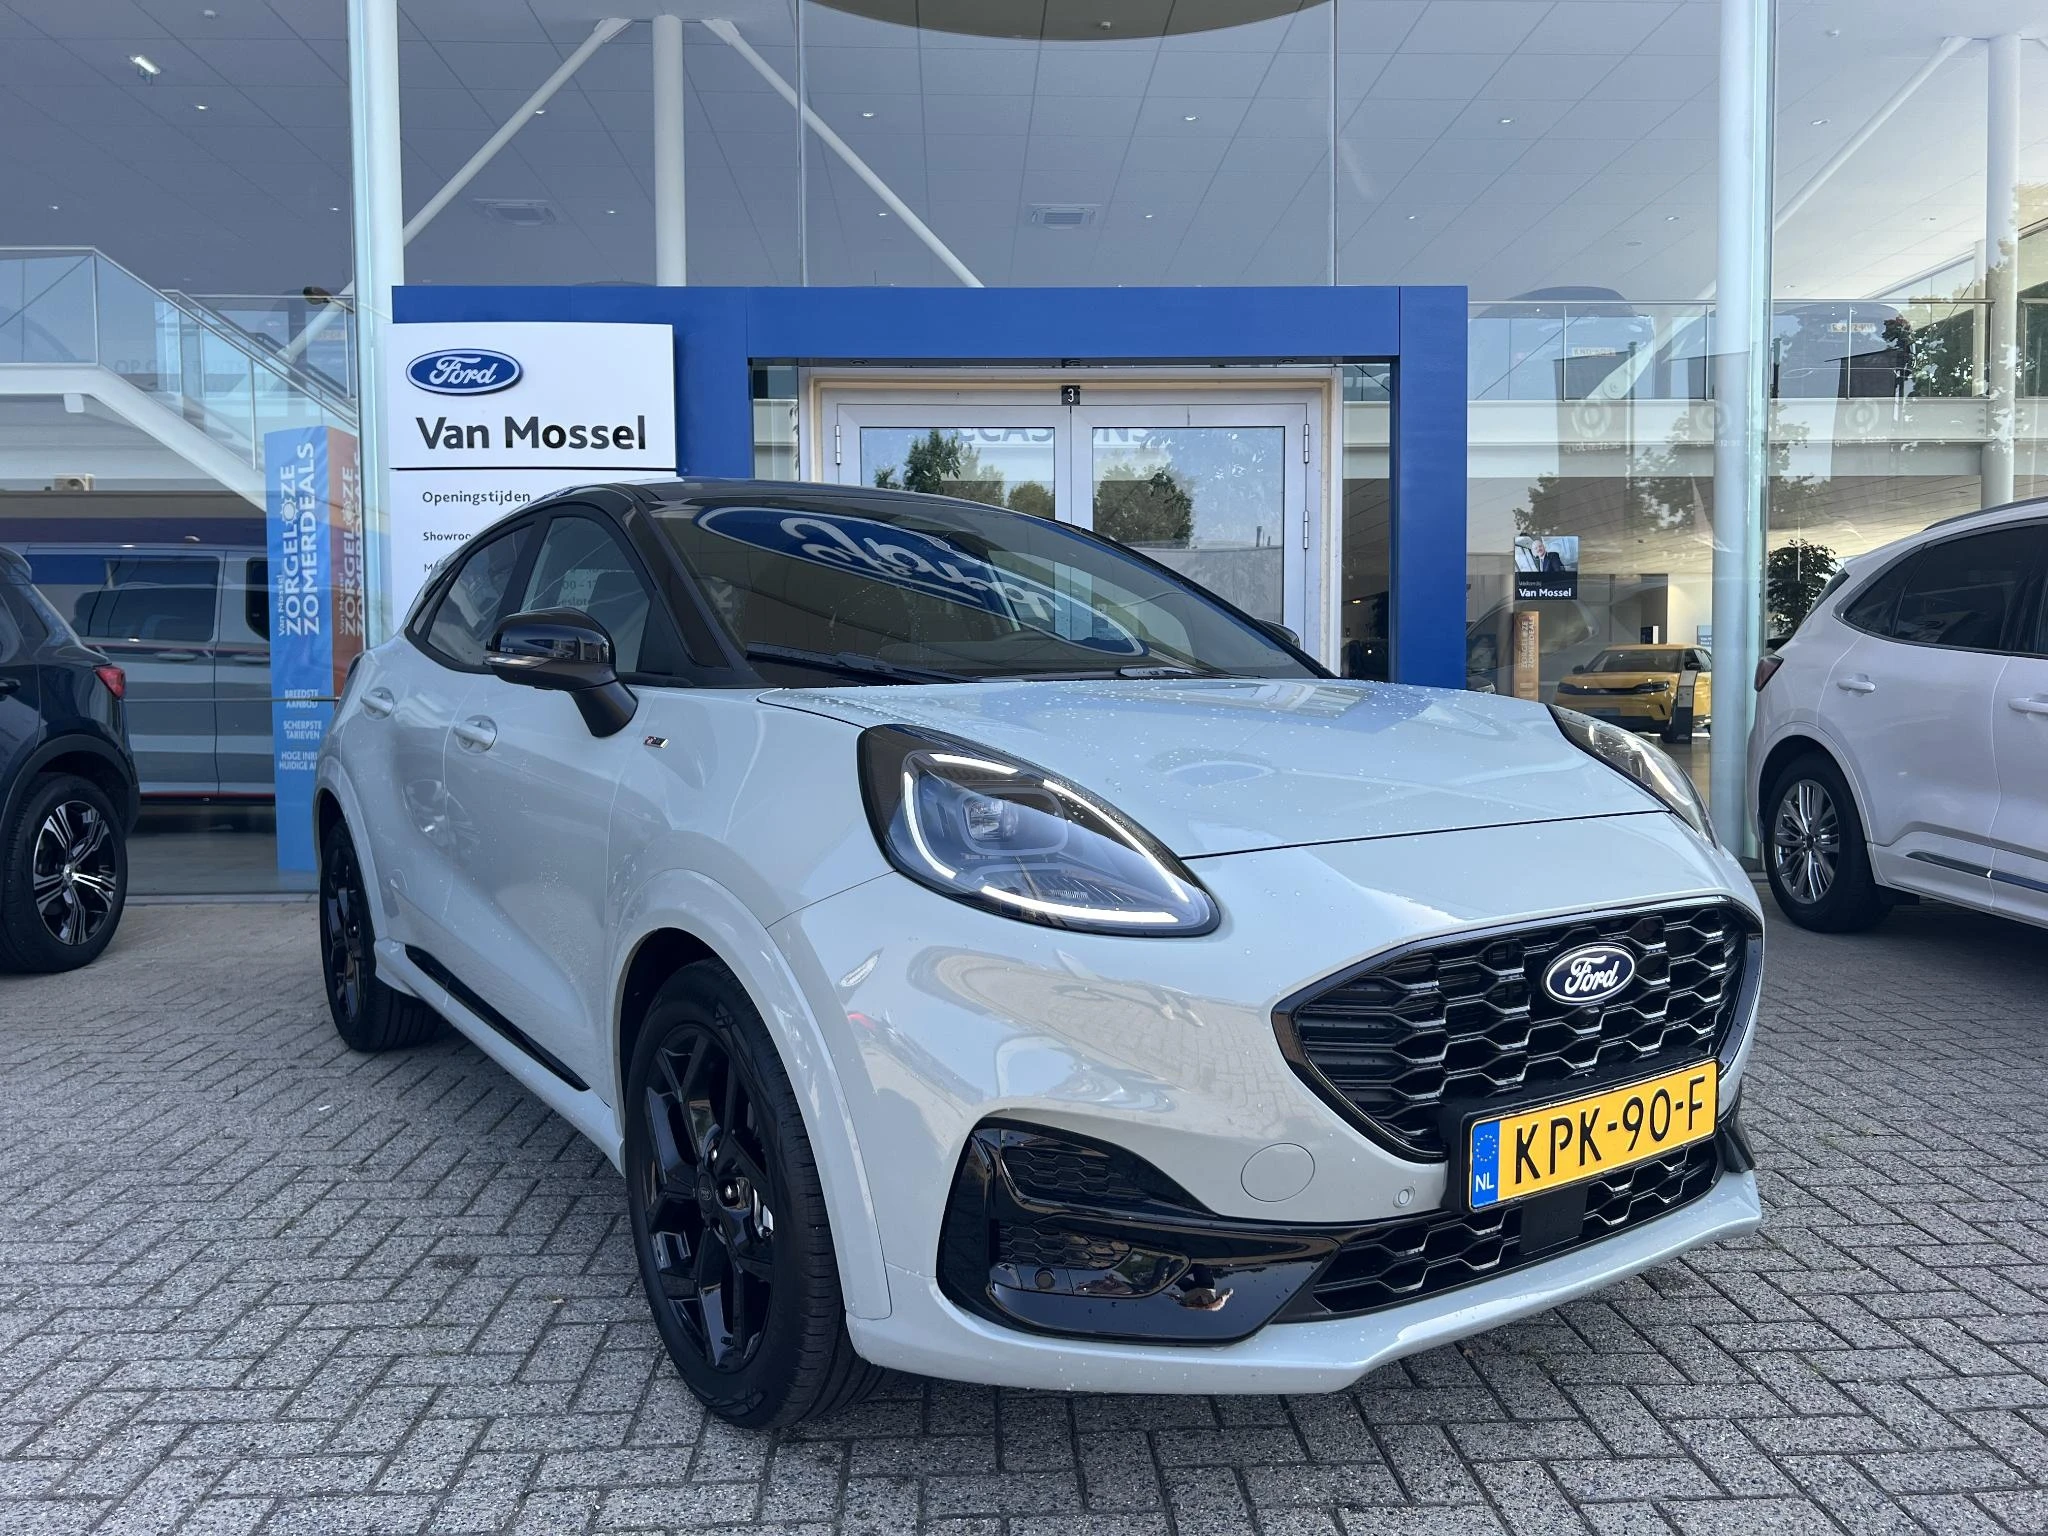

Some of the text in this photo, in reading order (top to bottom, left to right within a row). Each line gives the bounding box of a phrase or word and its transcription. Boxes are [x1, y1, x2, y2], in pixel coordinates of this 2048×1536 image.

[428, 355, 498, 385] Ford
[1067, 388, 1075, 403] 3
[415, 415, 646, 450] Van Mossel
[422, 490, 531, 506] Openingstijden
[297, 442, 320, 636] ZOMERDEALS
[1519, 588, 1572, 597] Van Mossel
[278, 615, 286, 637] Van
[284, 689, 319, 698] BREEDSTE
[283, 720, 322, 730] SCHERPSTE
[286, 730, 320, 740] TARIEVEN
[281, 751, 301, 760] HOGE
[279, 761, 307, 770] HUIDIGE
[1563, 954, 1621, 995] Ford
[1514, 1075, 1705, 1184] KPK-90-F
[1475, 1171, 1495, 1193] NL
